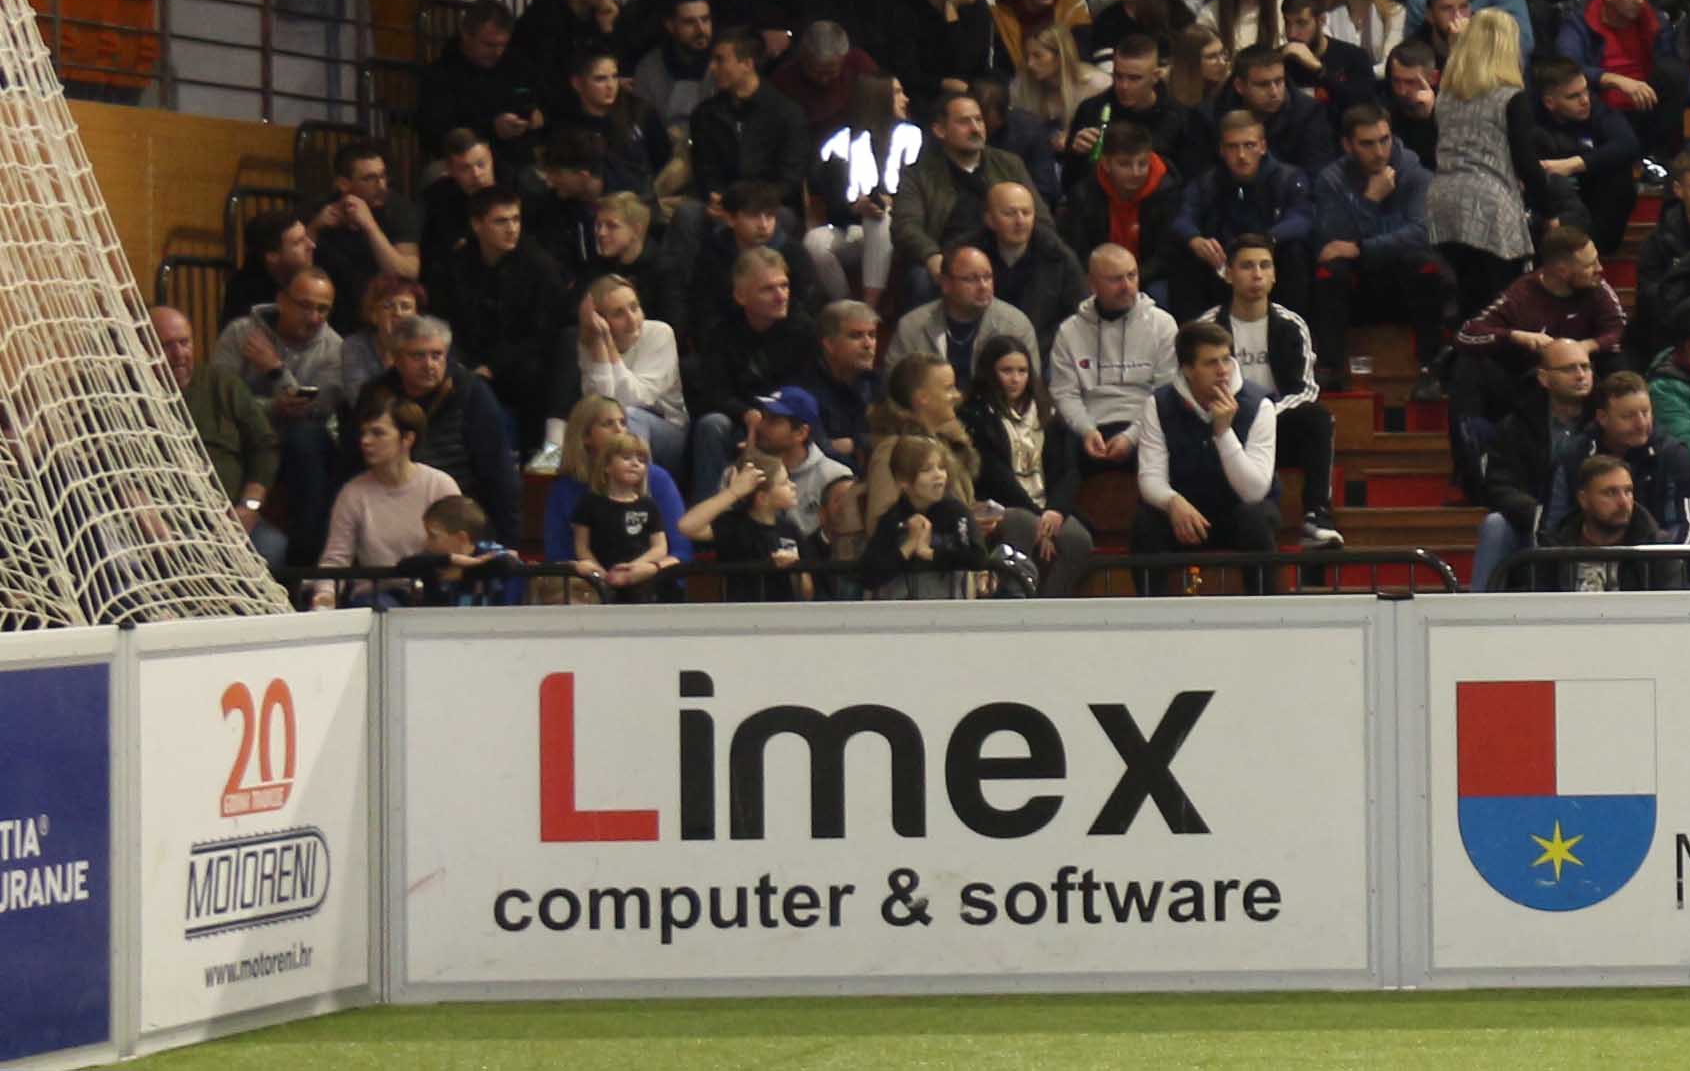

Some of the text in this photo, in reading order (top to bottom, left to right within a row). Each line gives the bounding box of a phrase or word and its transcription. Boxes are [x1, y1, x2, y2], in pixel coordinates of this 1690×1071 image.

[220, 677, 297, 817] 20
[539, 670, 1216, 843] Limex
[186, 840, 317, 921] MOTORENI
[493, 865, 1283, 946] computer & software
[204, 941, 313, 988] www.motoreni.hr
